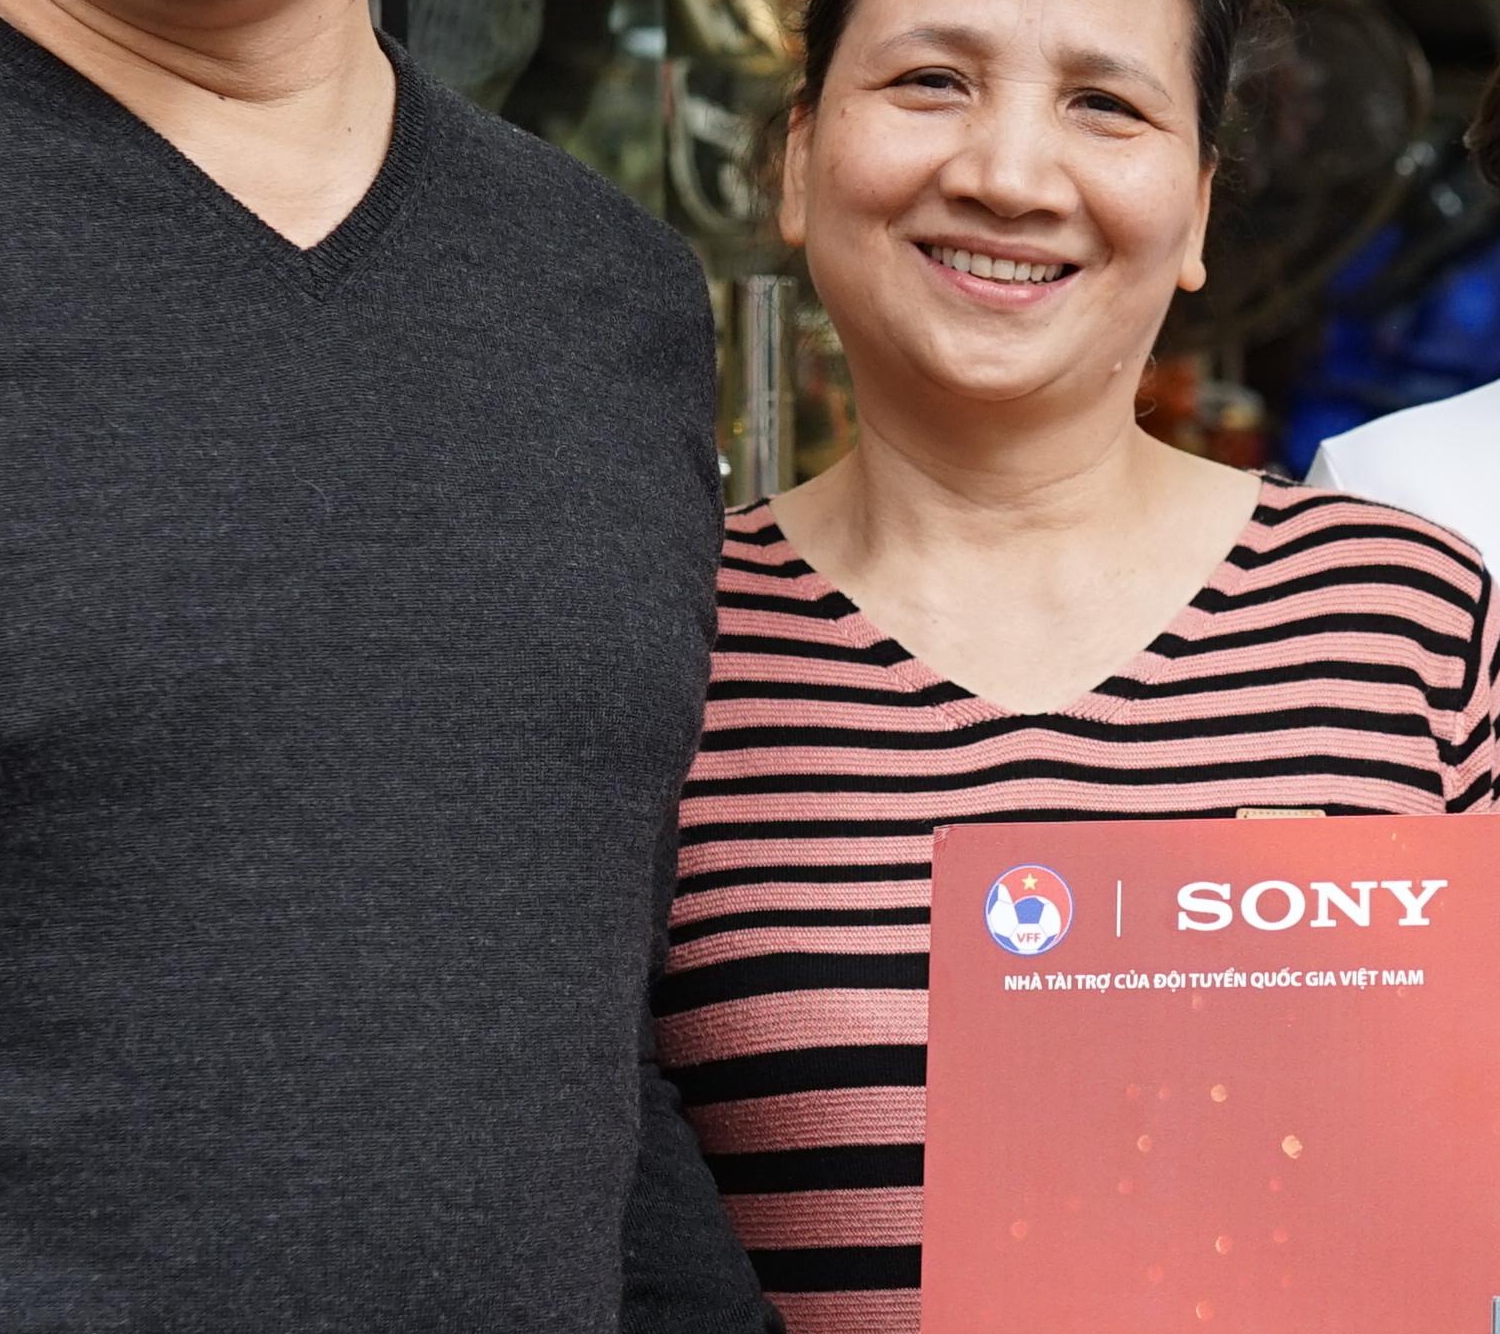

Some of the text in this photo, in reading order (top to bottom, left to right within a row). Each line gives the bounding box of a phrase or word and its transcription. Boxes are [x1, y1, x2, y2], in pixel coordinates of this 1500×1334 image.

[1178, 880, 1447, 932] SONY
[1016, 932, 1041, 943] VFF
[1004, 967, 1424, 993] NHÀ TÀI TRỢ CỦA ĐỘI TUYỂN QUỐC GIA VIỆT NAM
